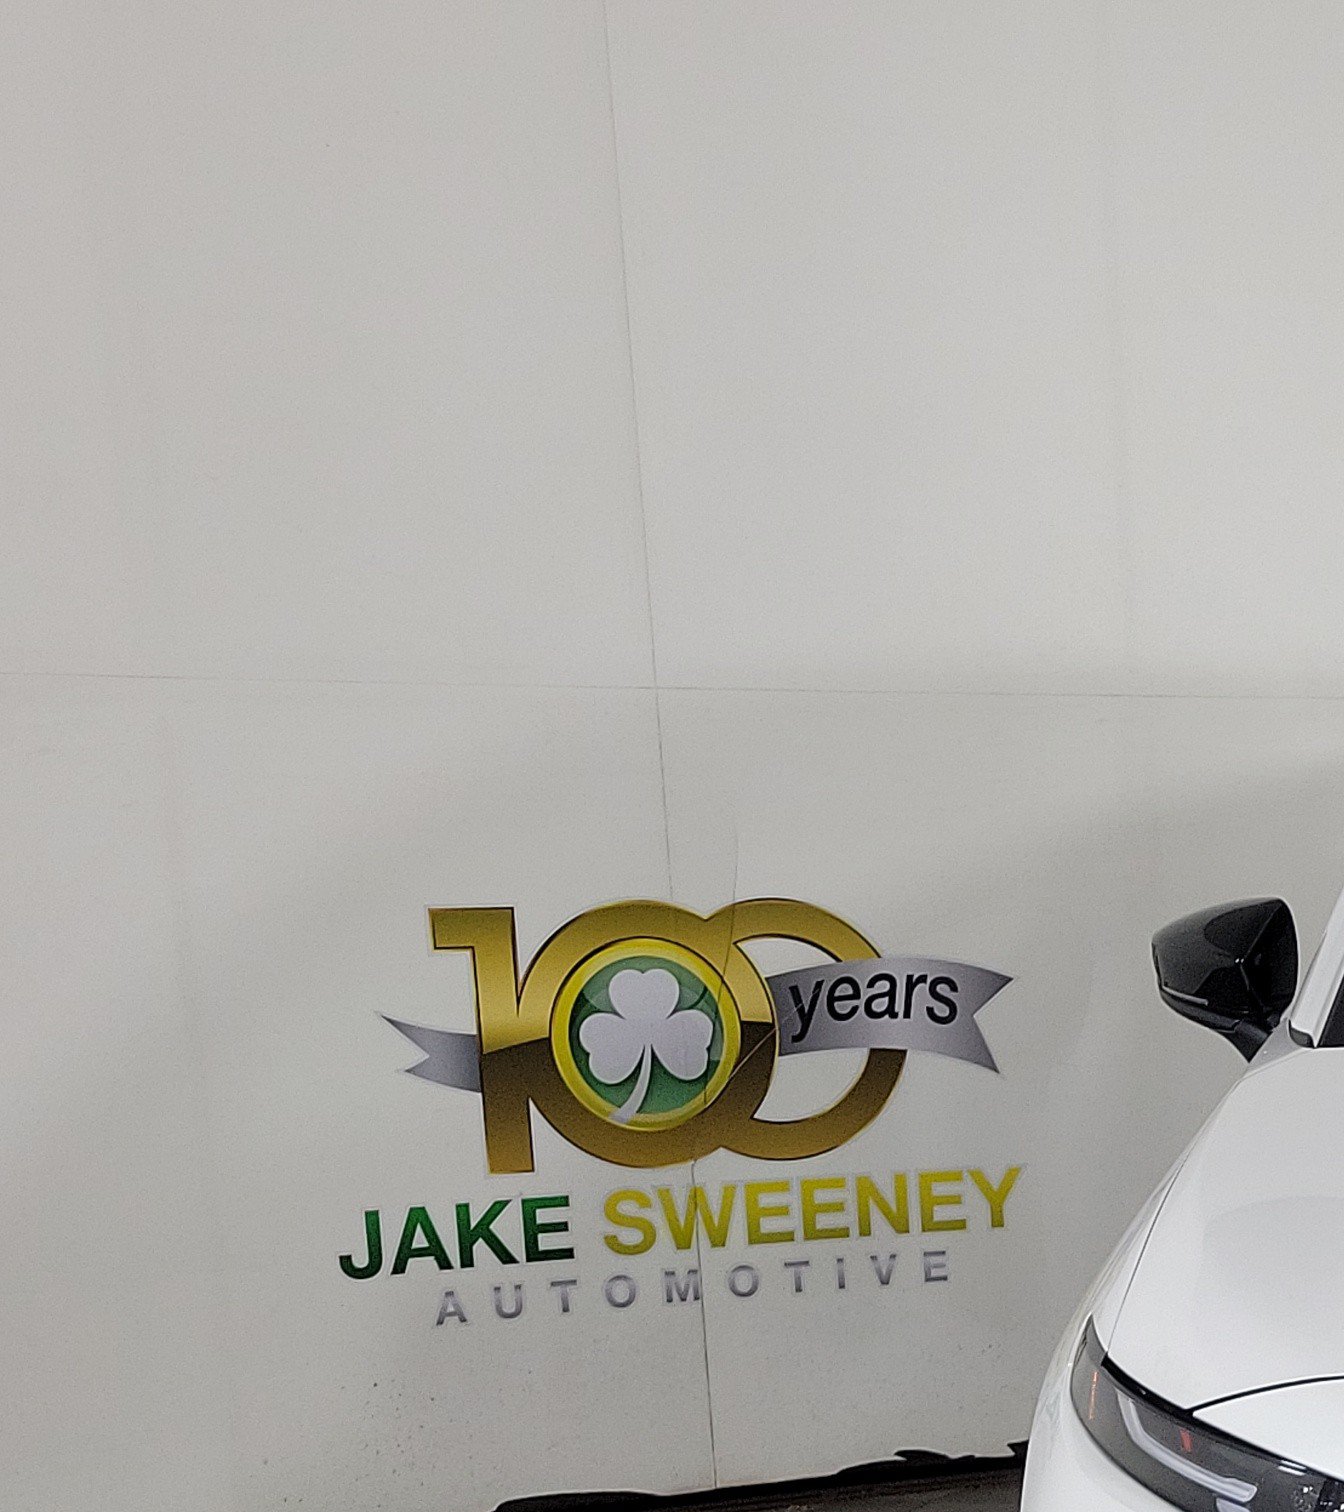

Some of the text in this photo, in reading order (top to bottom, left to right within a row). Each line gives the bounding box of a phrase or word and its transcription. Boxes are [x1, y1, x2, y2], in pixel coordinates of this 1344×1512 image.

[428, 898, 960, 1173] 100 years
[339, 1166, 1023, 1280] JAKE SWEENEY
[436, 1250, 949, 1326] AUTOMOTIVE
